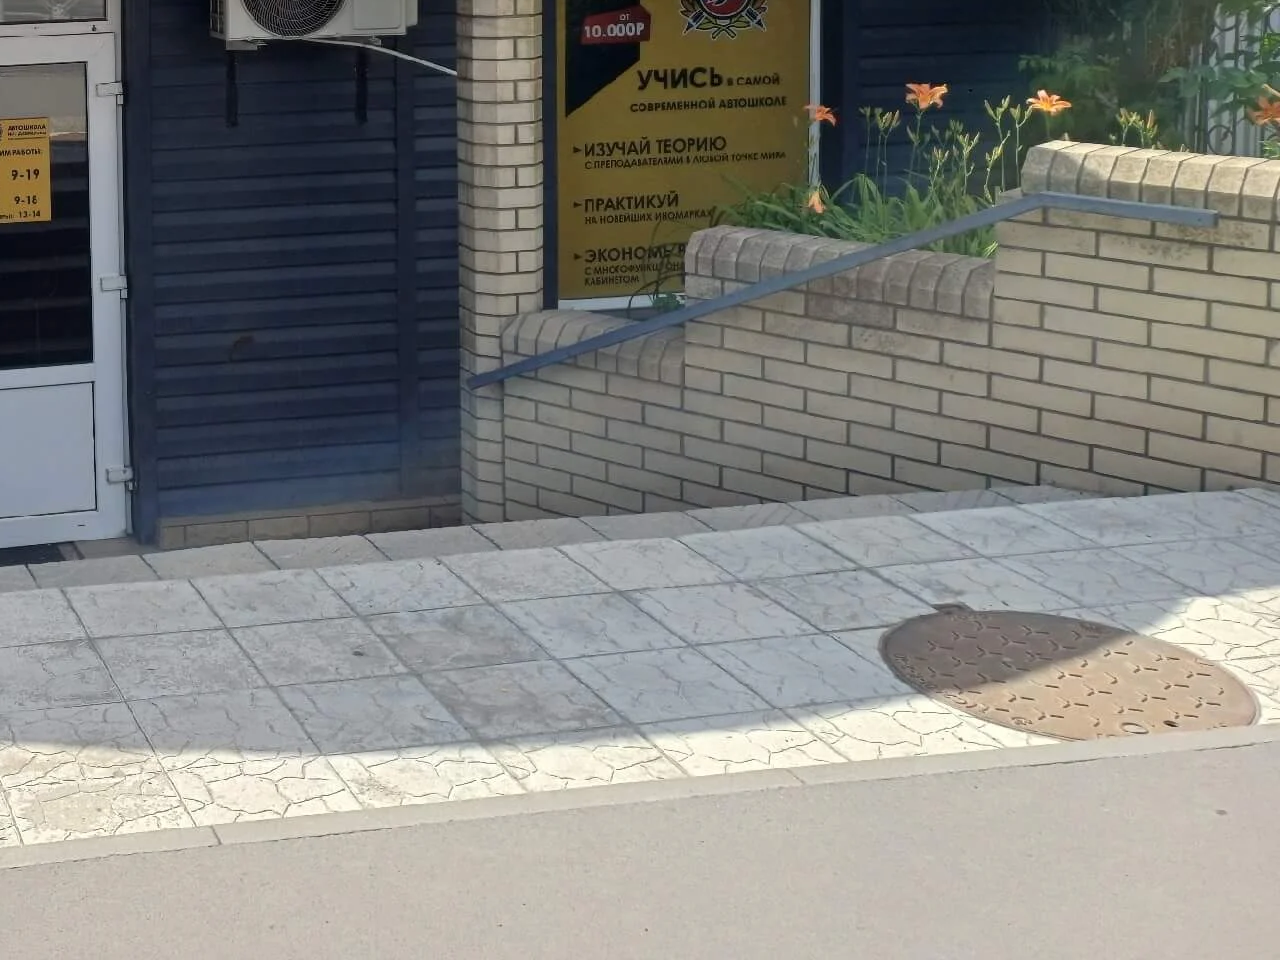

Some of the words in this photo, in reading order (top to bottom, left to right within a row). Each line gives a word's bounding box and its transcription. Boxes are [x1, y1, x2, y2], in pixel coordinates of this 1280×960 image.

[636, 67, 723, 91] УЧИСЬ
[736, 72, 781, 86] САМОЙ
[630, 97, 716, 112] СОВРЕМЕННОЙ
[719, 96, 787, 109] АВТОШКОЛЕ
[584, 136, 651, 157] ИЗУЧАЙ
[656, 136, 727, 154] ТЕОРИЮ
[11, 169, 40, 181] 9-19
[584, 190, 680, 213] ПРАКТИКУЙ
[584, 217, 598, 225] НА
